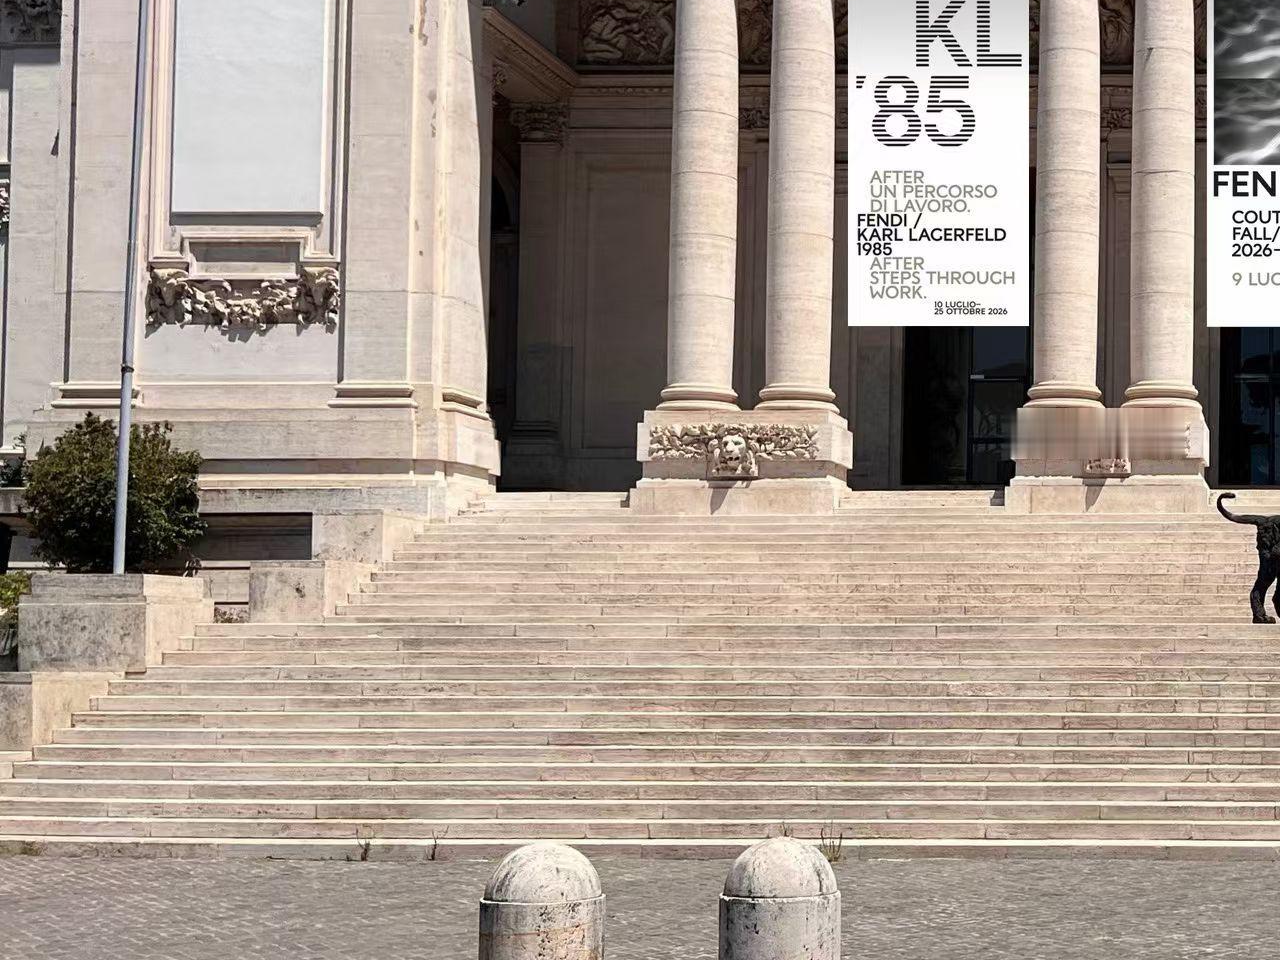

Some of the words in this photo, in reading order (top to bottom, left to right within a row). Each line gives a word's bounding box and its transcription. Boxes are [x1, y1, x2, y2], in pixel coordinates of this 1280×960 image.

[870, 170, 925, 184] AFTER
[870, 185, 897, 198] UN
[903, 185, 998, 198] PERCORSO
[870, 200, 887, 213] DI
[894, 200, 971, 213] LAVORO.
[857, 214, 907, 227] FENDI
[857, 228, 903, 241] KARL
[909, 228, 1007, 241] LAGERFELD
[857, 242, 893, 256] 1985
[870, 257, 925, 270] AFTER
[870, 271, 921, 285] STEPS
[926, 271, 1016, 285] THROUGH
[1232, 272, 1242, 286] 9
[870, 286, 927, 299] WORK.
